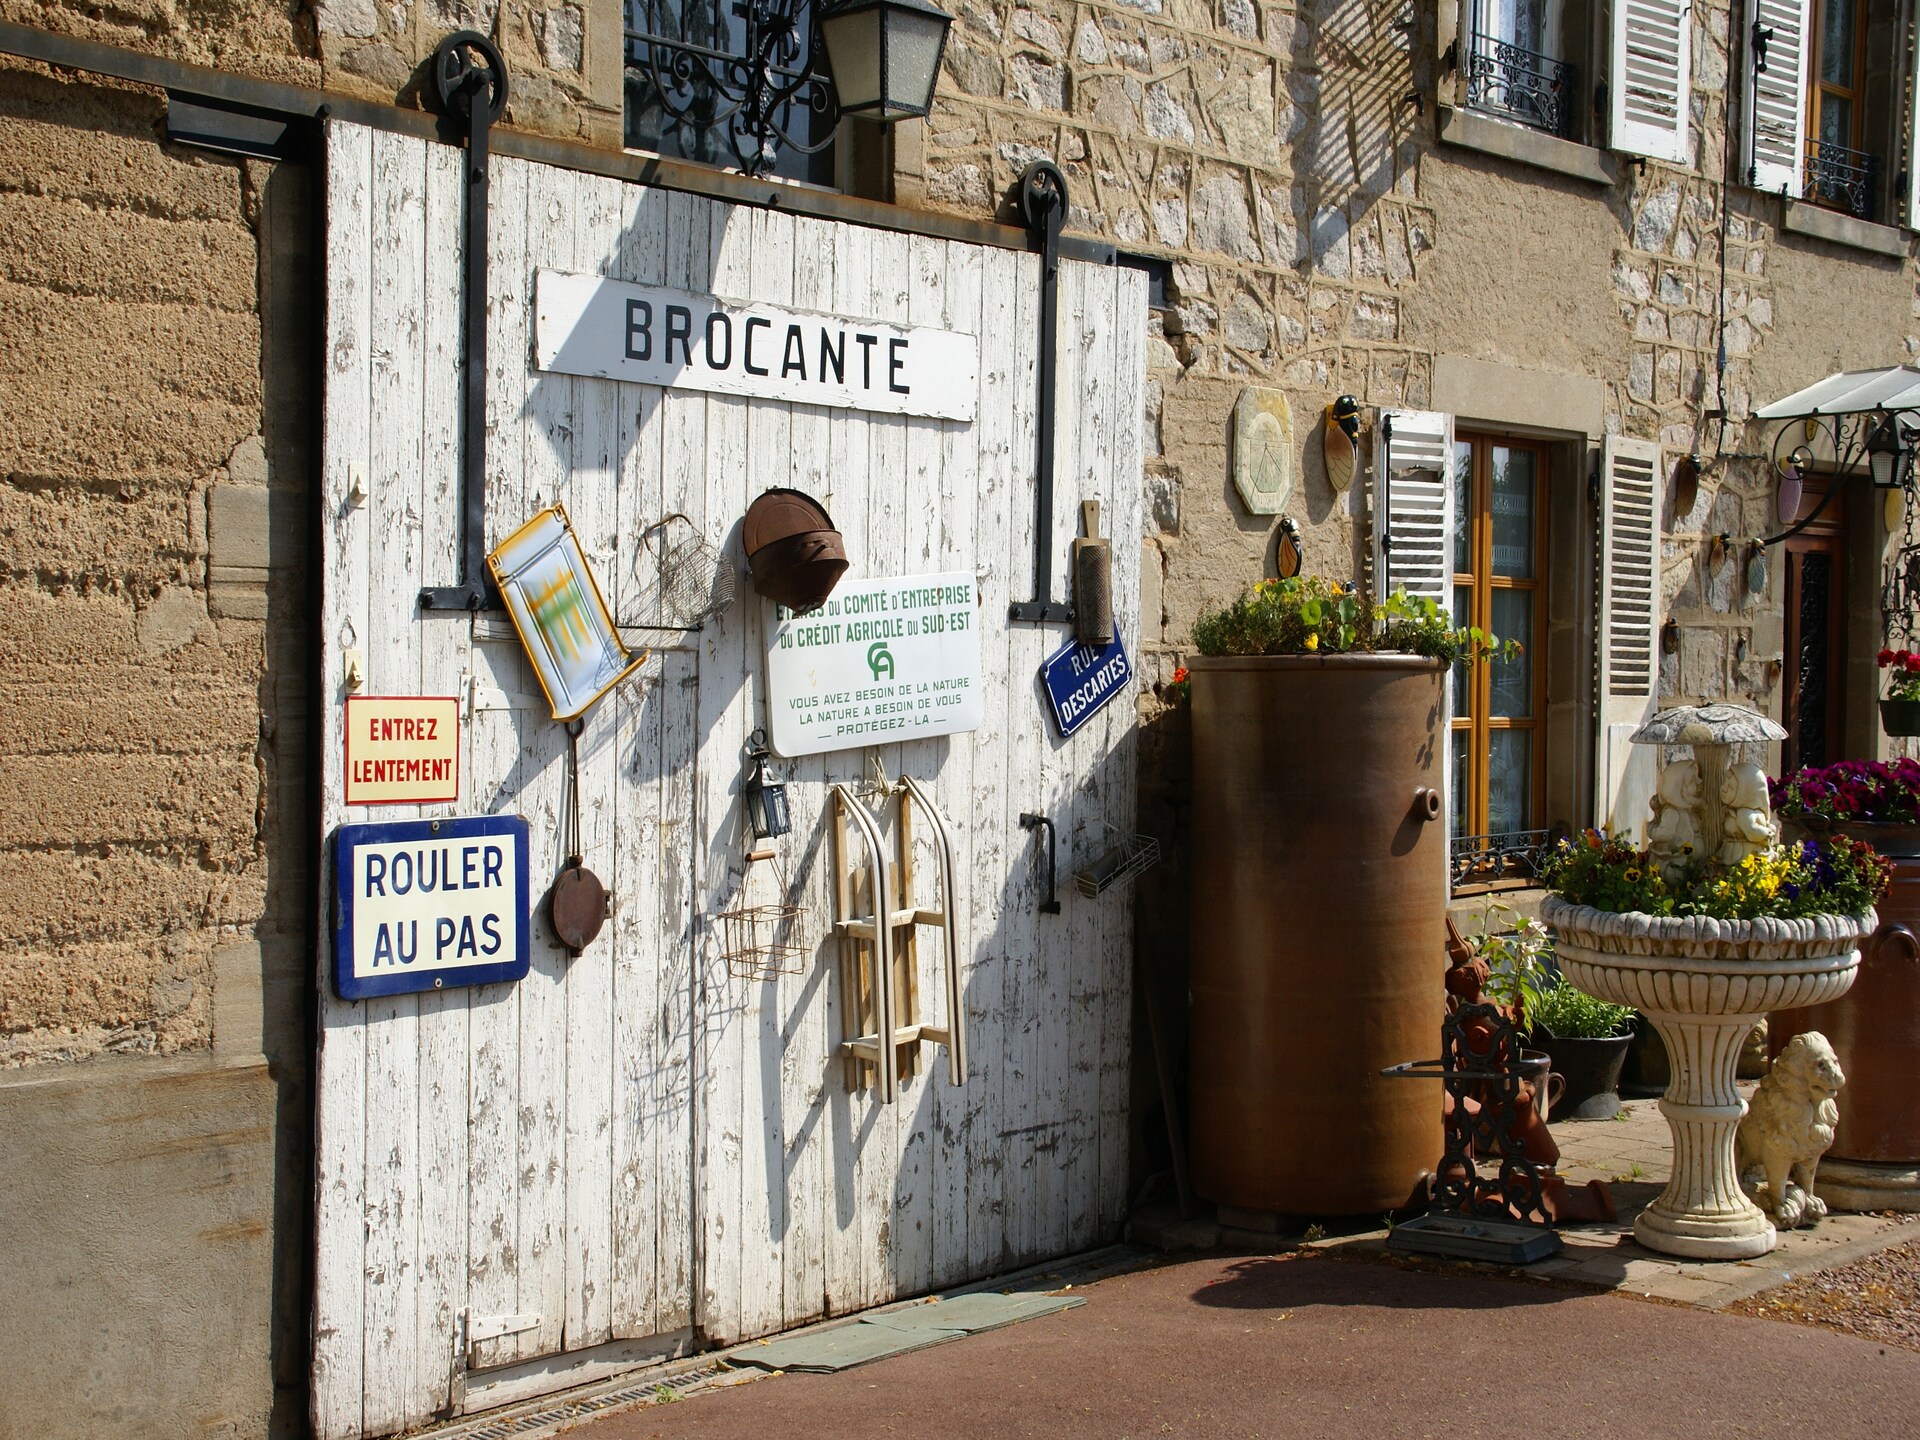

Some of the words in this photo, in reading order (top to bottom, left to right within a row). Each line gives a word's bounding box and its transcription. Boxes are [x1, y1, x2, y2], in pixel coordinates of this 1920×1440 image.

[625, 298, 910, 394] BROCANTE
[828, 600, 841, 616] DU
[844, 589, 888, 614] COMITÉ
[780, 633, 793, 649] DU
[797, 623, 841, 647] CRÉDIT
[846, 618, 904, 642] AGRICOLE
[907, 620, 918, 636] DU
[1070, 645, 1099, 676] RUE
[789, 696, 819, 709] VOUS
[824, 692, 850, 705] AVEZ
[855, 687, 894, 701] BESOIN
[899, 684, 912, 695] DE
[916, 683, 928, 693] LA
[932, 677, 969, 691] NATURE
[1061, 653, 1126, 723] DESCARTES
[799, 714, 813, 725] LA
[818, 707, 859, 722] NATURE
[864, 706, 871, 716] A
[875, 700, 913, 714] BESOIN
[917, 698, 931, 709] DE
[935, 694, 962, 706] VOUS
[370, 718, 438, 741] ENTREZ
[354, 758, 452, 783] LENTEMENT
[366, 845, 503, 898] ROULER
[372, 919, 418, 967] AU
[436, 913, 502, 961] PAS
